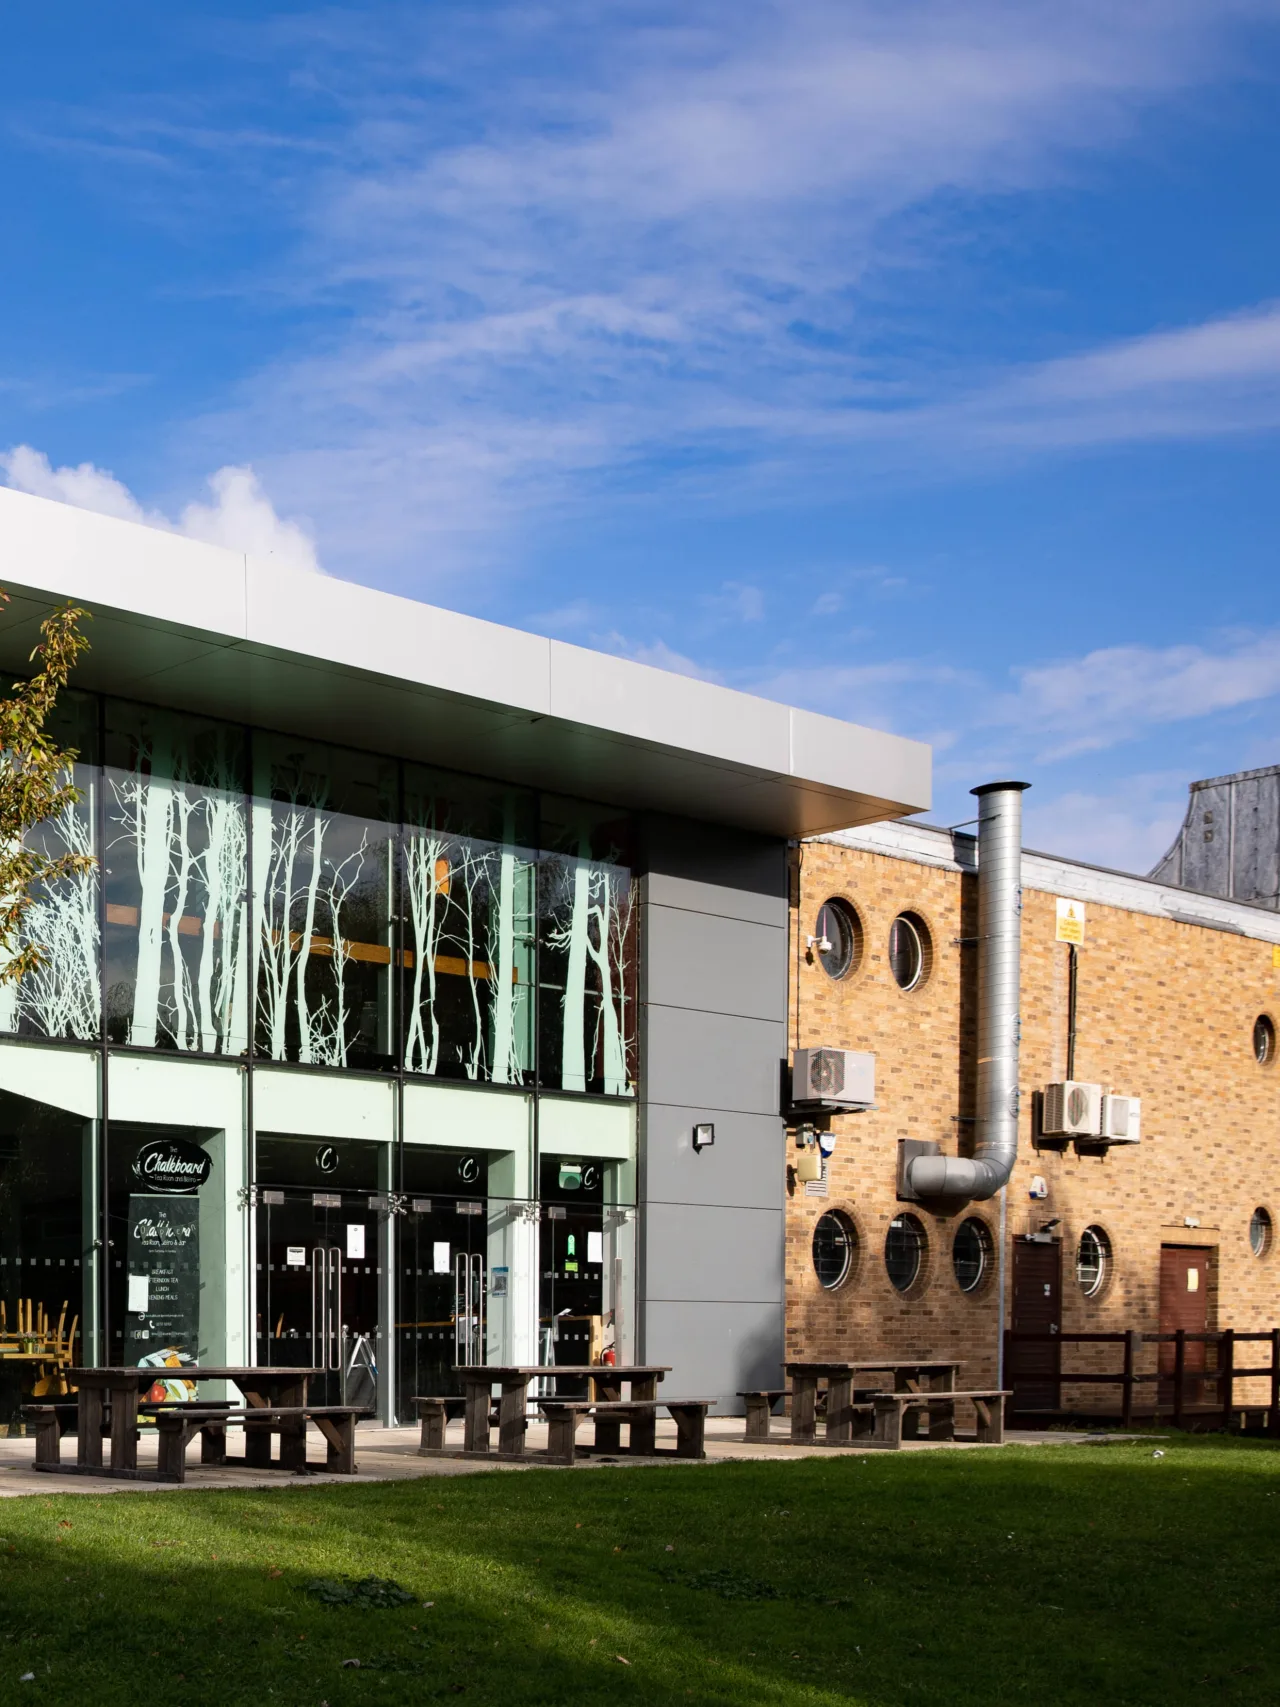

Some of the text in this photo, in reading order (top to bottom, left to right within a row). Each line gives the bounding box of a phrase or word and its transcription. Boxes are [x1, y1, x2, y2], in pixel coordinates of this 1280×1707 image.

[169, 1145, 178, 1153] The
[321, 1148, 332, 1169] C
[144, 1152, 207, 1174] Chalkboard
[463, 1159, 473, 1178] C
[584, 1166, 594, 1186] C
